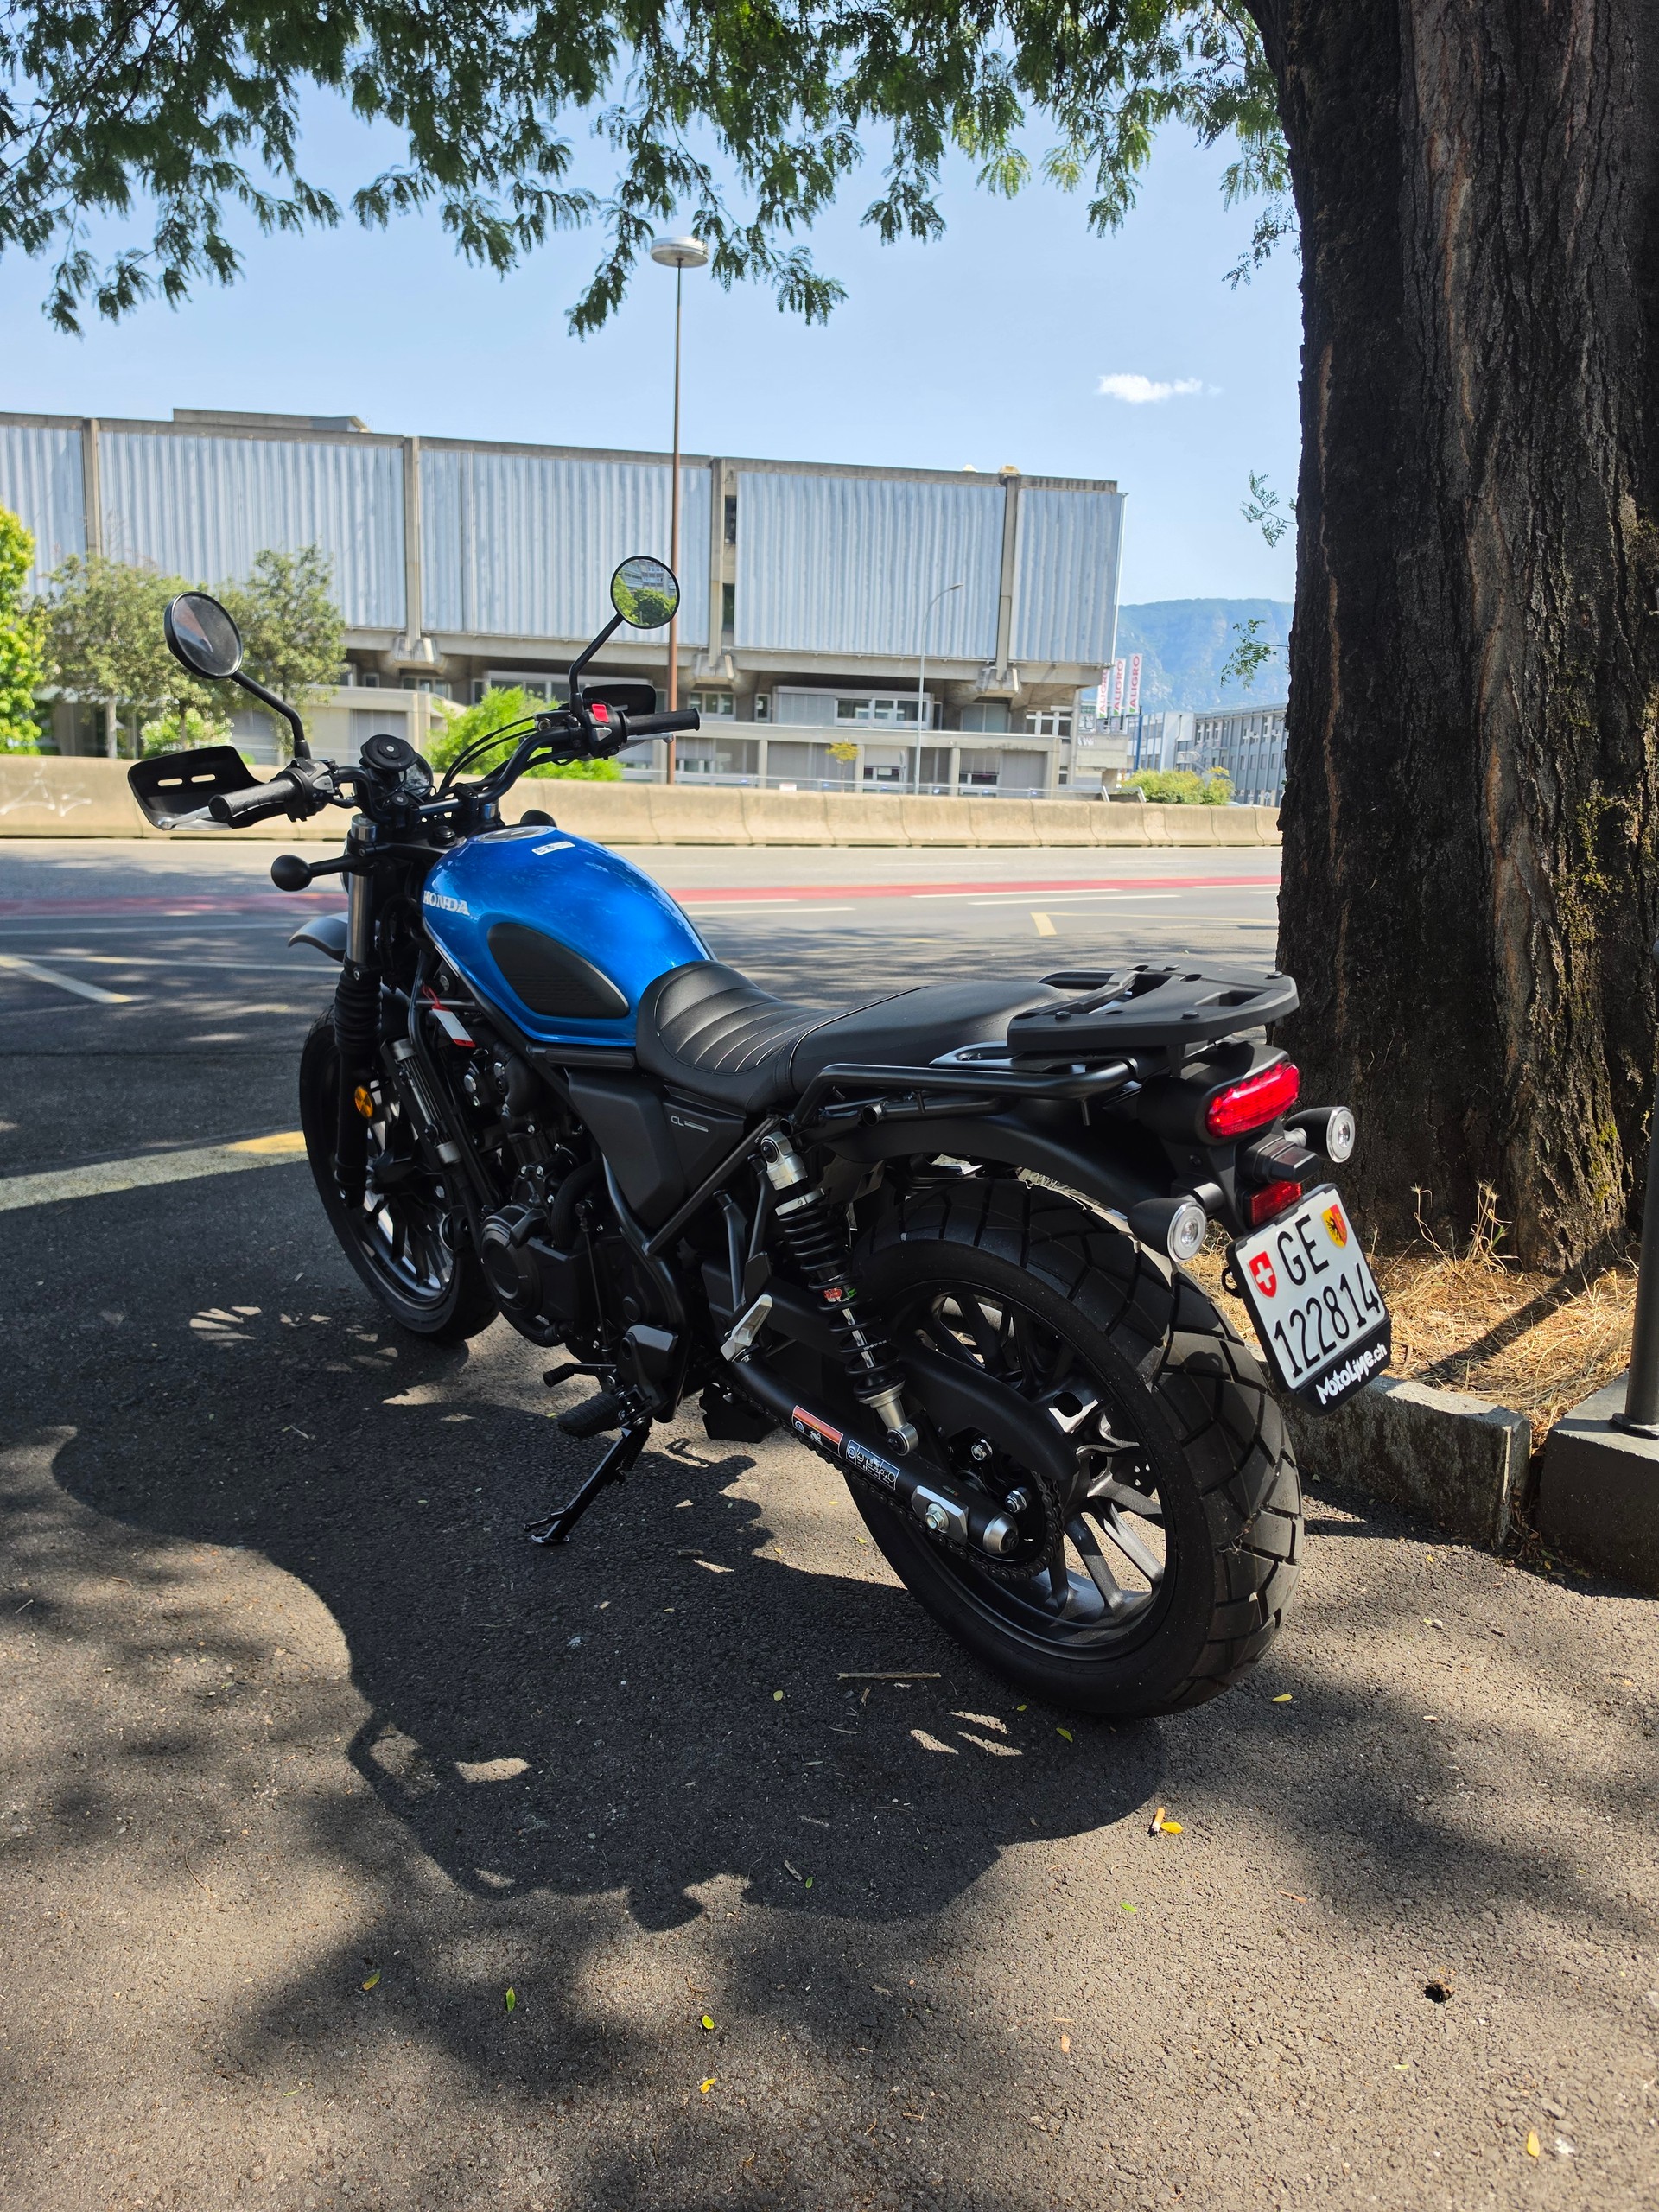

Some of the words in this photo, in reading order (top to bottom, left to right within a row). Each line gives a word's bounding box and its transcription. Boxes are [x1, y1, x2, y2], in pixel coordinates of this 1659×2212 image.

[1114, 660, 1123, 710] ALIGRO
[1129, 656, 1140, 708] ALIGRO
[423, 890, 470, 916] HONDA
[1277, 1214, 1329, 1286] GE
[1274, 1262, 1381, 1378] 122814
